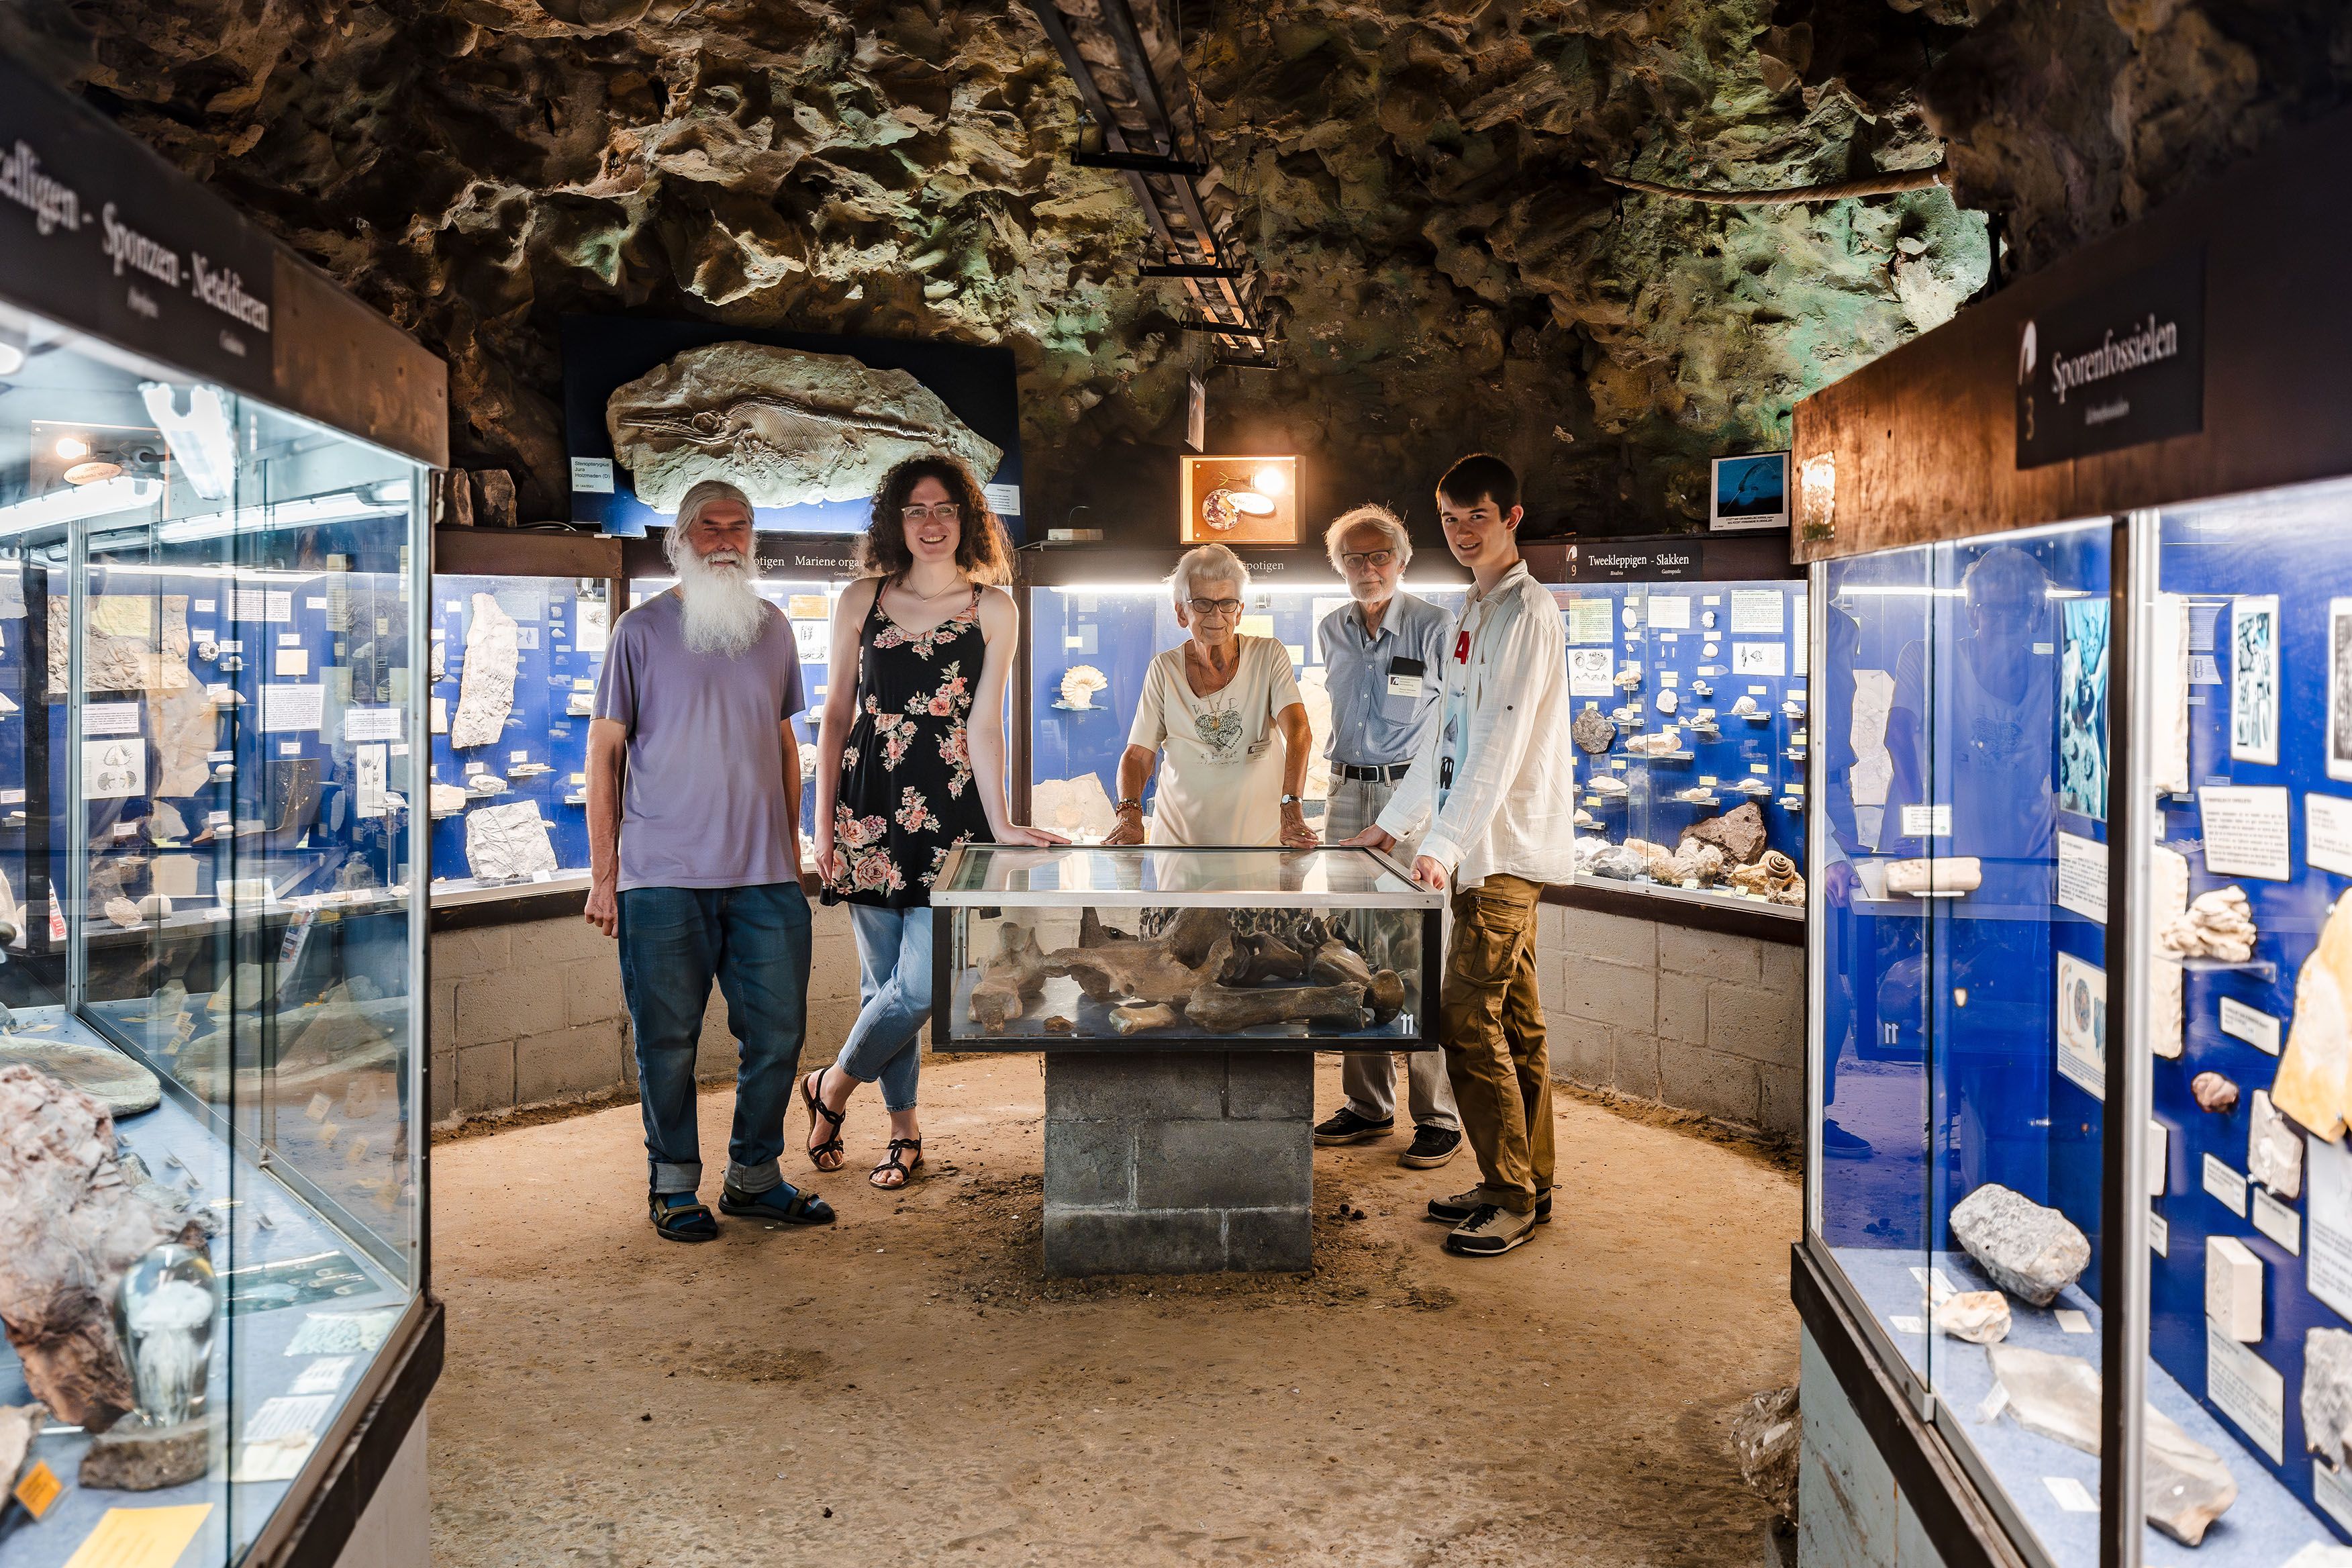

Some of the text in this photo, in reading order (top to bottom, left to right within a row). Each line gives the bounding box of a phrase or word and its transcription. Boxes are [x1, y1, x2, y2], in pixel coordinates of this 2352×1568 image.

[102, 201, 180, 288] Sponzen
[2051, 312, 2177, 404] Sporenfossielen
[754, 556, 785, 569] otigen
[795, 555, 836, 567] Mariene
[1244, 560, 1284, 573] potigen
[1588, 554, 1647, 569] Tweekleppigen
[1656, 554, 1689, 566] Slakken
[1571, 565, 1577, 577] 9
[1401, 1014, 1414, 1034] 11
